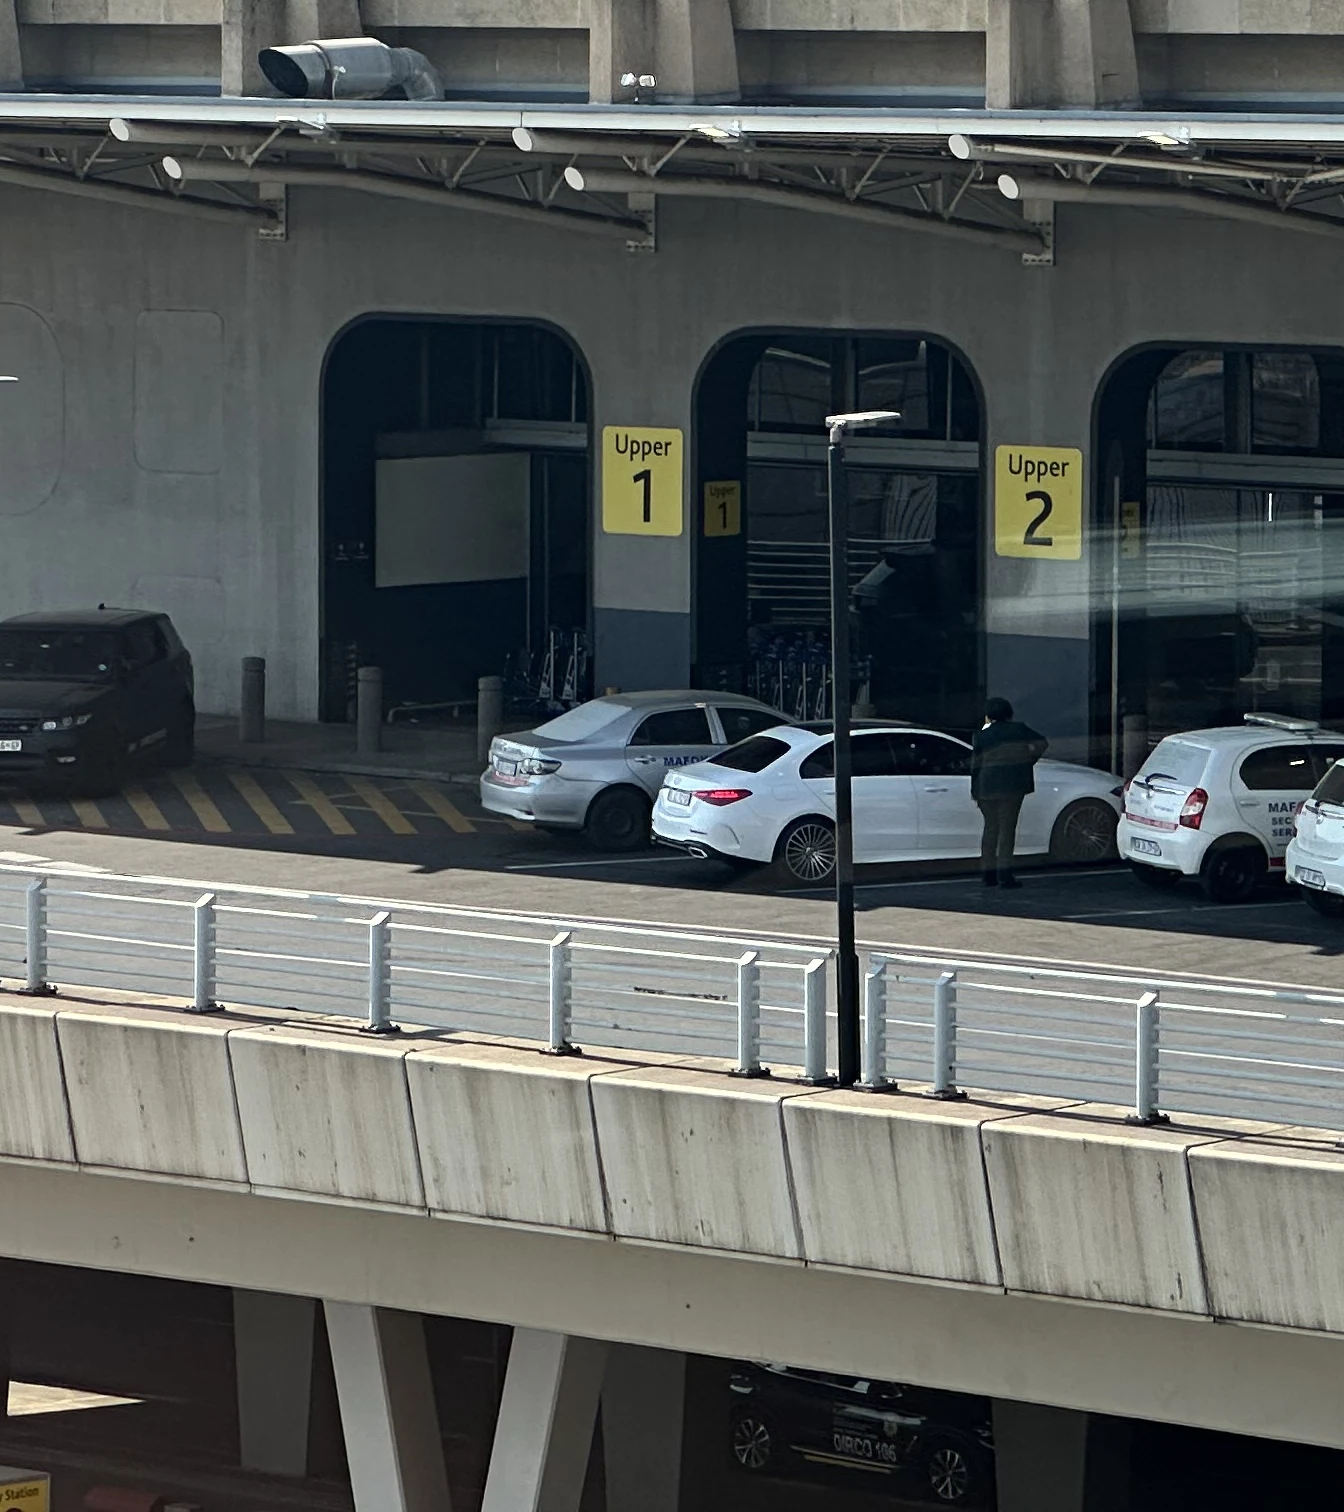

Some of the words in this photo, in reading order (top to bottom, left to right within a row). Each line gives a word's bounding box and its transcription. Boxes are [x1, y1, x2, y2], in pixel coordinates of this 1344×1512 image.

[615, 433, 672, 459] Upper
[1007, 454, 1070, 482] Upper
[632, 469, 652, 523] 1
[718, 501, 727, 530] 1
[1023, 490, 1053, 547] 2
[1268, 801, 1297, 813] MAF
[5, 1486, 39, 1501] Station
